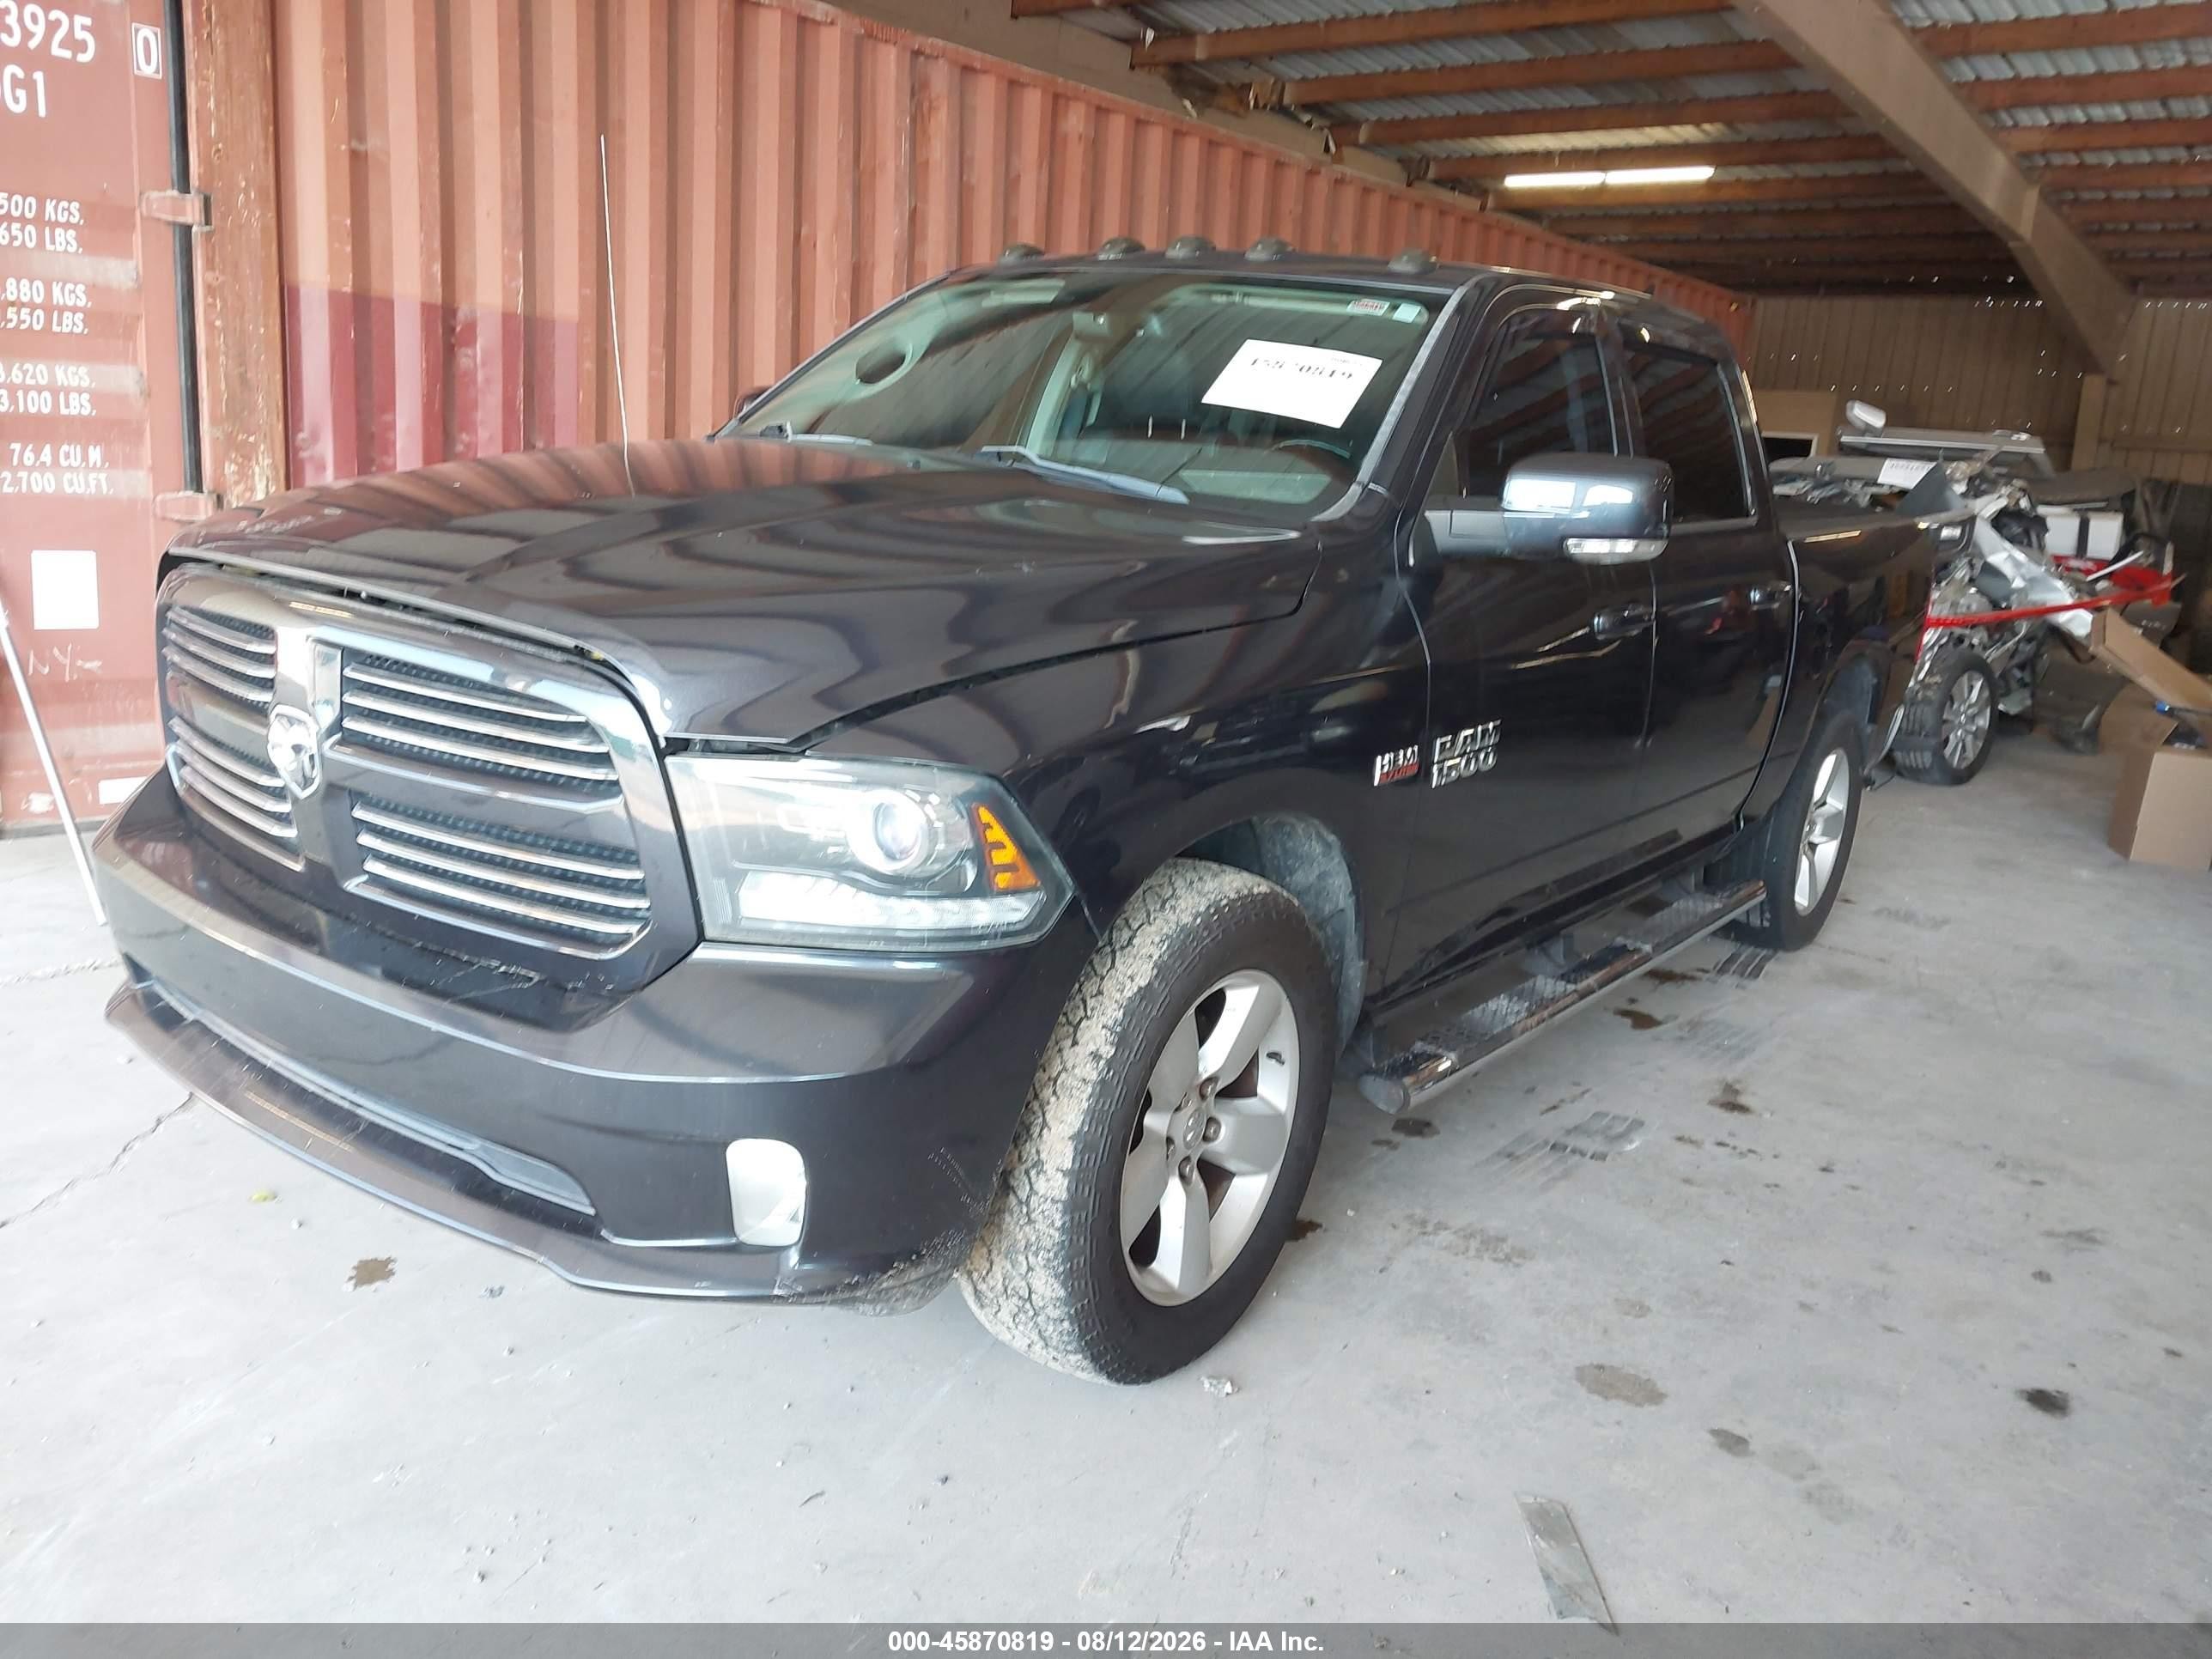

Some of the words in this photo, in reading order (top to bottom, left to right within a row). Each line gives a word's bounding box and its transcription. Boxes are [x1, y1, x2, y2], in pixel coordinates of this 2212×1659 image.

[0, 0, 95, 63] 3925
[137, 27, 158, 74] 0
[0, 191, 37, 219] 500
[0, 222, 37, 249] 650
